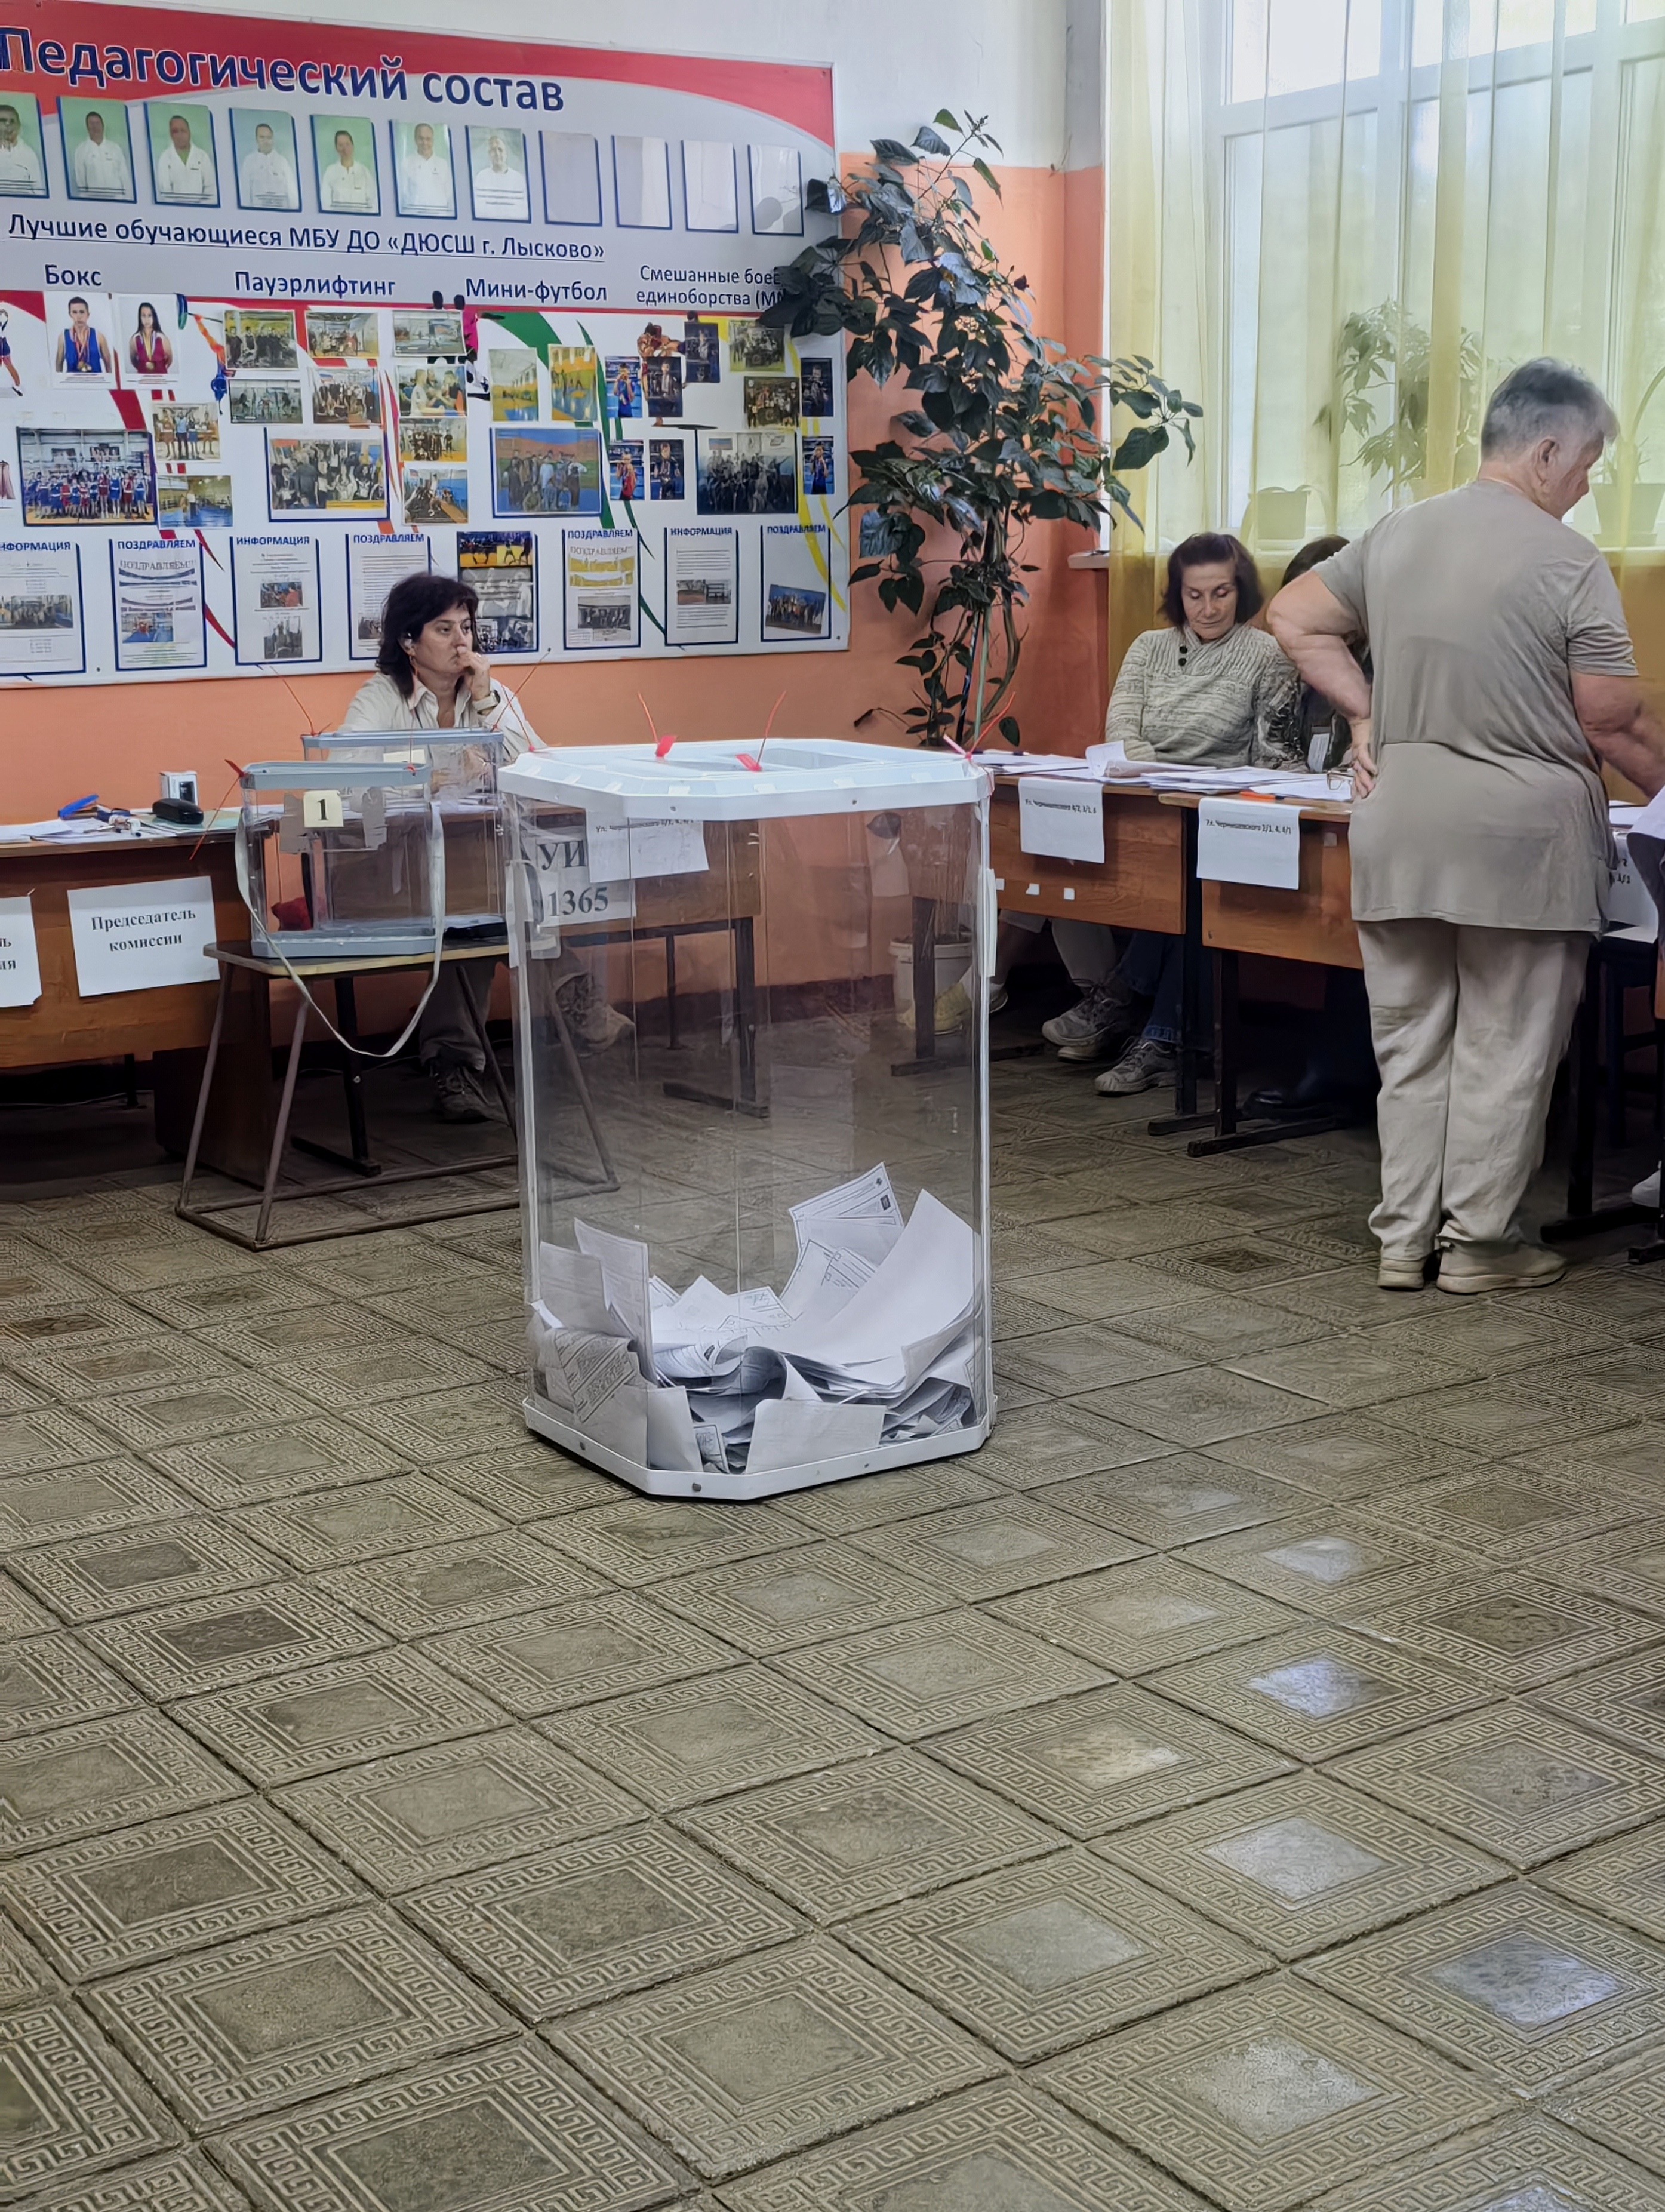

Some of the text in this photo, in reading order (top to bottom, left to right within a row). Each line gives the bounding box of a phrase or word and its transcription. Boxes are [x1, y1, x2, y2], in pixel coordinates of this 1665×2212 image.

[0, 26, 564, 112] Педагогический состав
[8, 214, 604, 259] Лучшие обучающиеся МБУ ДО «ДЮСШ г. Лысково»
[44, 264, 103, 287] Бокс
[640, 264, 740, 284] Смешанные
[235, 270, 396, 299] Пауэрлифтинг
[466, 278, 607, 304] Мини-футбол
[636, 288, 750, 307] единоборства
[353, 534, 425, 544] ПОЗДРАВЛЯЕМ
[568, 529, 633, 540] ПОЗДРАВЛЯЕМ
[670, 527, 733, 536] ИНФОРМАЦИЯ
[767, 524, 826, 534] ПОЗДРАВЛЯЕМ
[0, 541, 70, 553] НФОРМАЦИЯ
[118, 540, 196, 550] ПОЗДРАВЛЯЕМ
[236, 534, 310, 545] ИНФОРМАЦИЯ
[317, 798, 329, 821] 1
[537, 839, 587, 871] УИ
[548, 887, 608, 916] 1365
[91, 909, 196, 932] Председатель
[109, 934, 183, 952] комиссии
